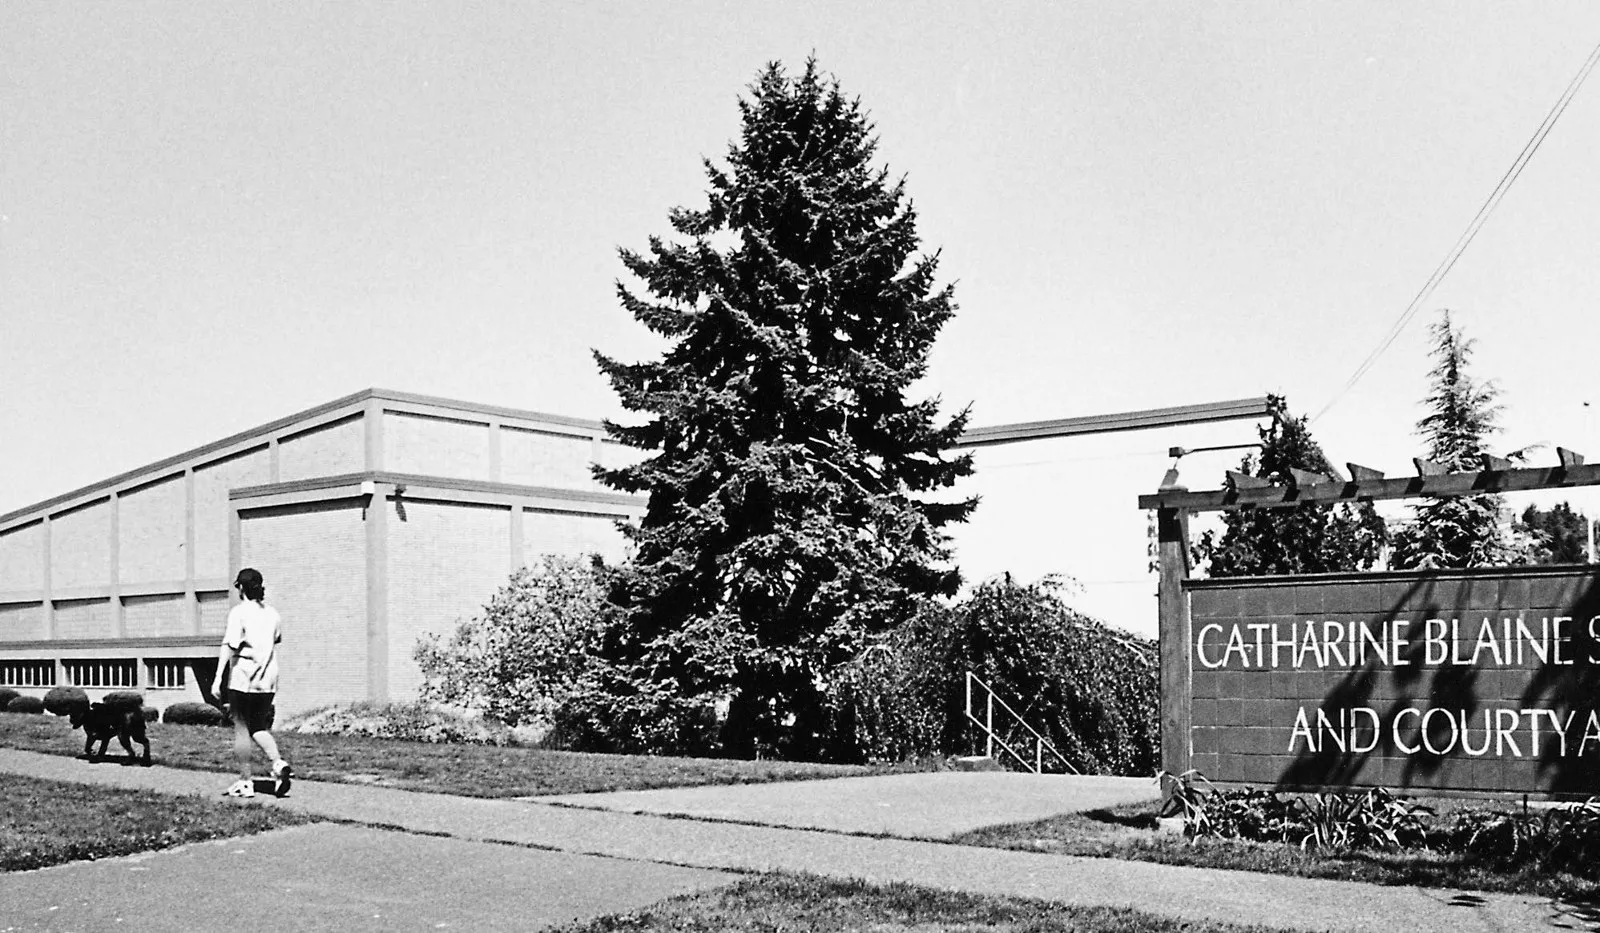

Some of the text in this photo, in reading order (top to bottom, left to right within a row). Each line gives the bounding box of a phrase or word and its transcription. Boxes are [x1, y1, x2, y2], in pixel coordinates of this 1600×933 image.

[1197, 620, 1410, 668] CATHARINE
[1425, 617, 1573, 666] BLAINE
[1288, 706, 1381, 753] AND
